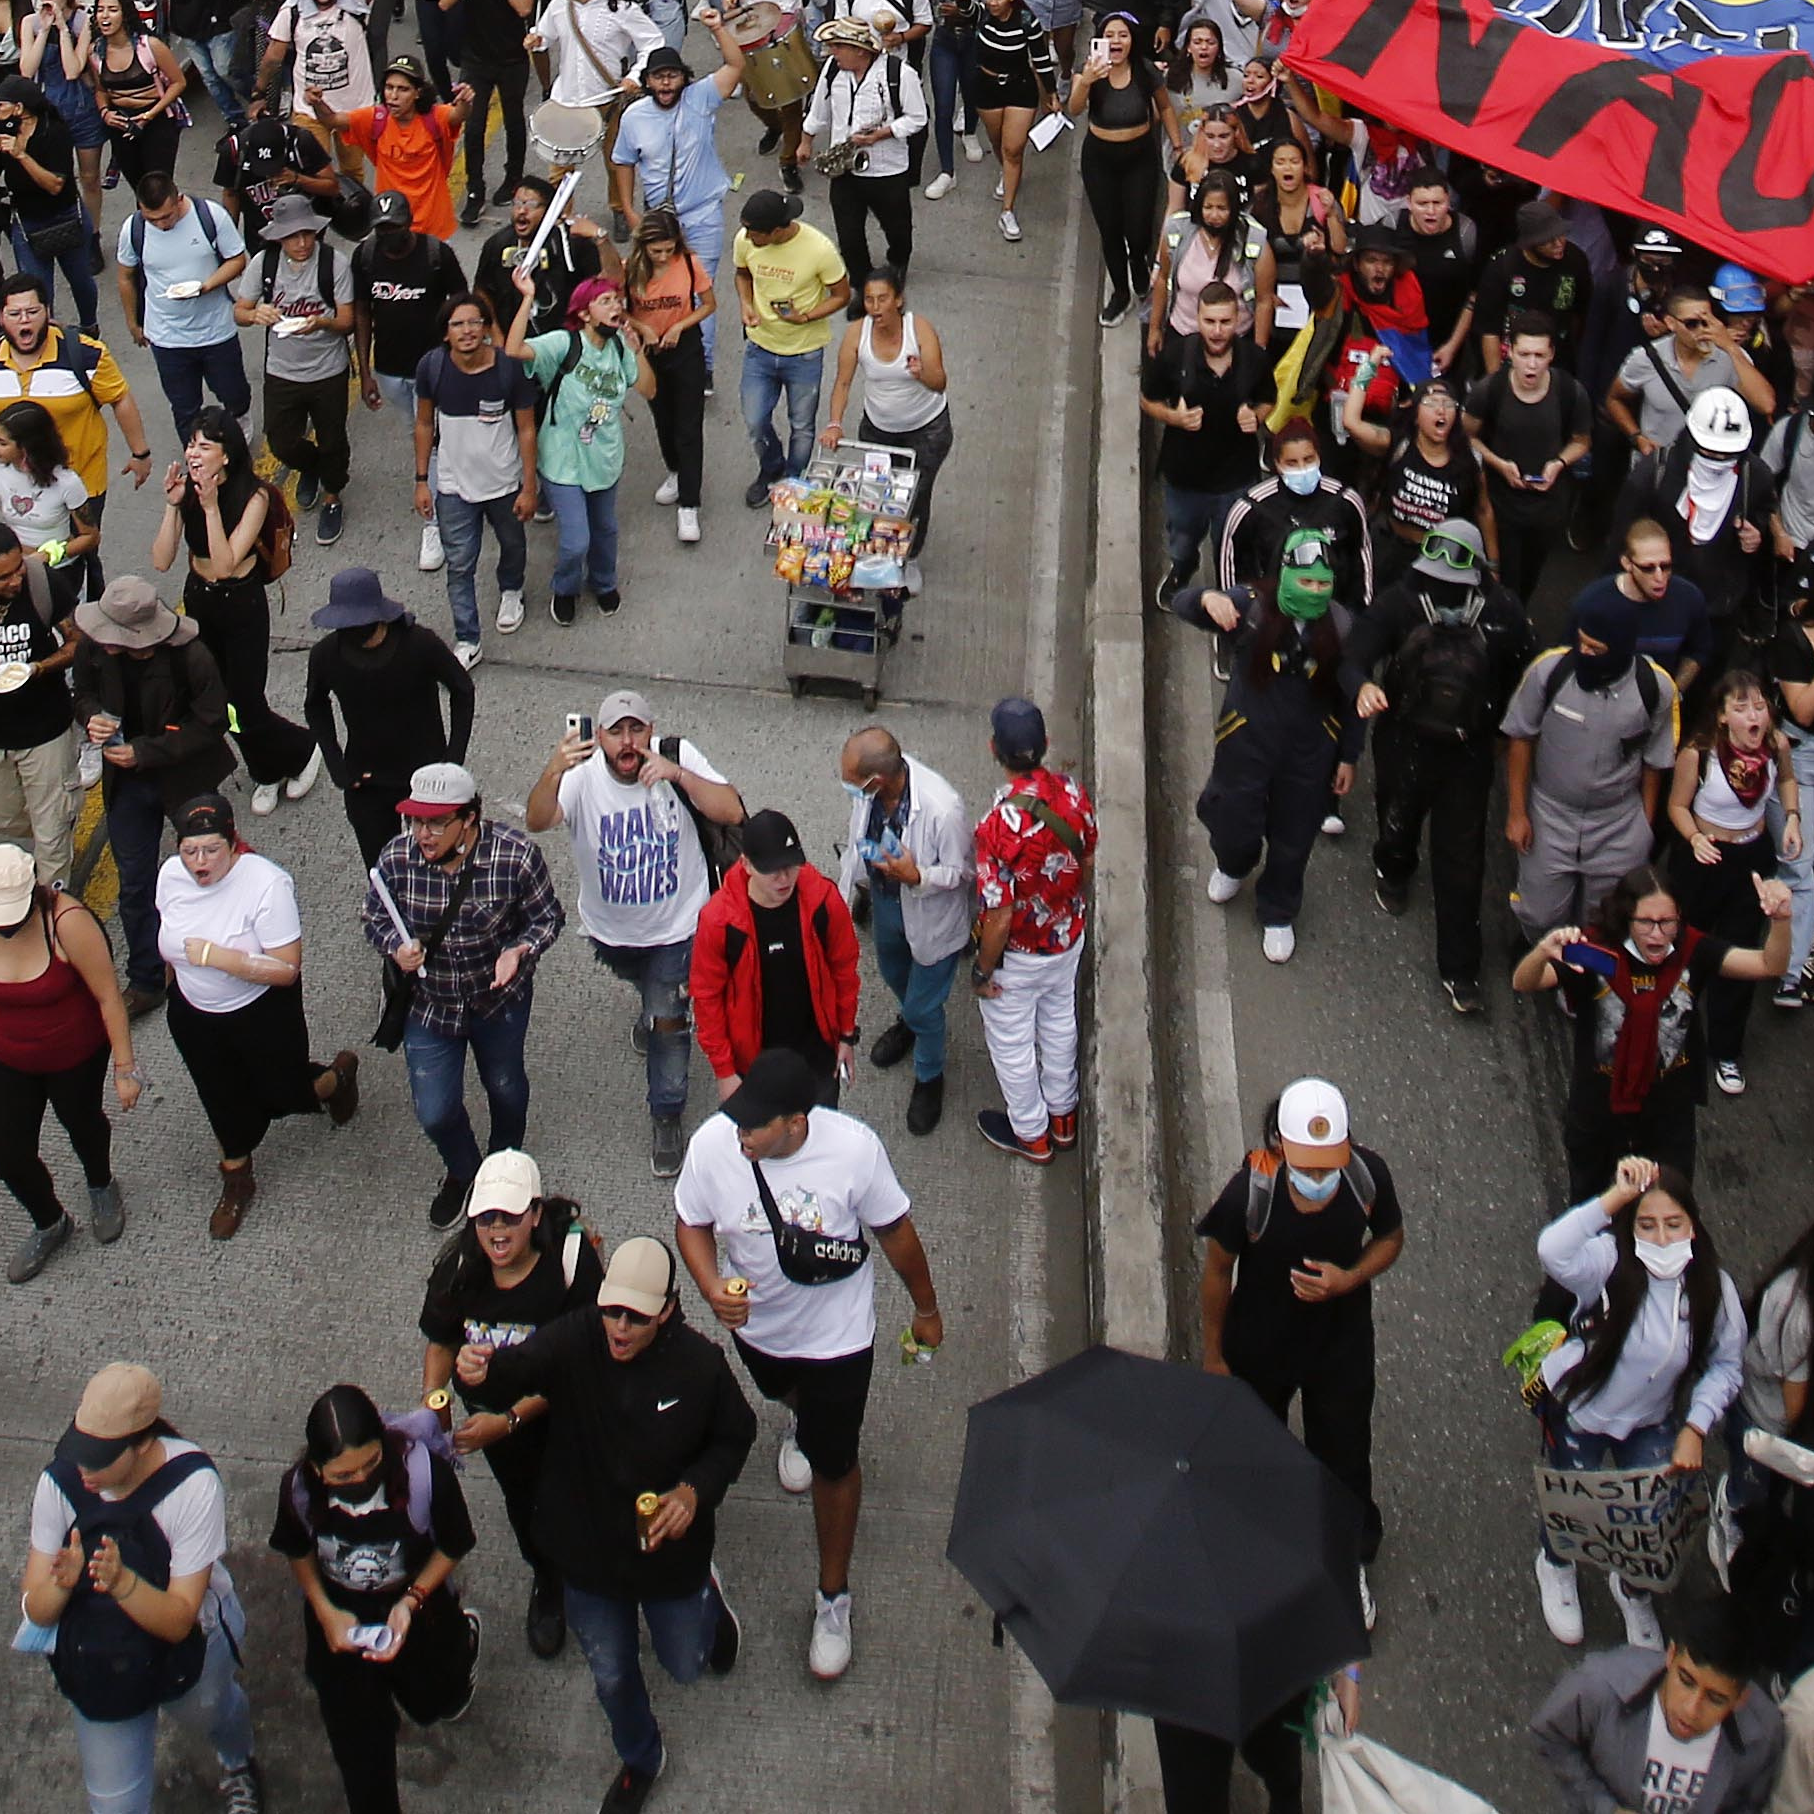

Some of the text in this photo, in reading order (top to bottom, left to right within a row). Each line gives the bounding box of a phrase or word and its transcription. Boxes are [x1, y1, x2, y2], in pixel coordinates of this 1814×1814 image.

[597, 830, 679, 872] SOME
[598, 859, 679, 907] WAVES
[814, 1239, 863, 1265] adidas
[1543, 1473, 1668, 1502] HASTA
[1546, 1511, 1588, 1536] SE
